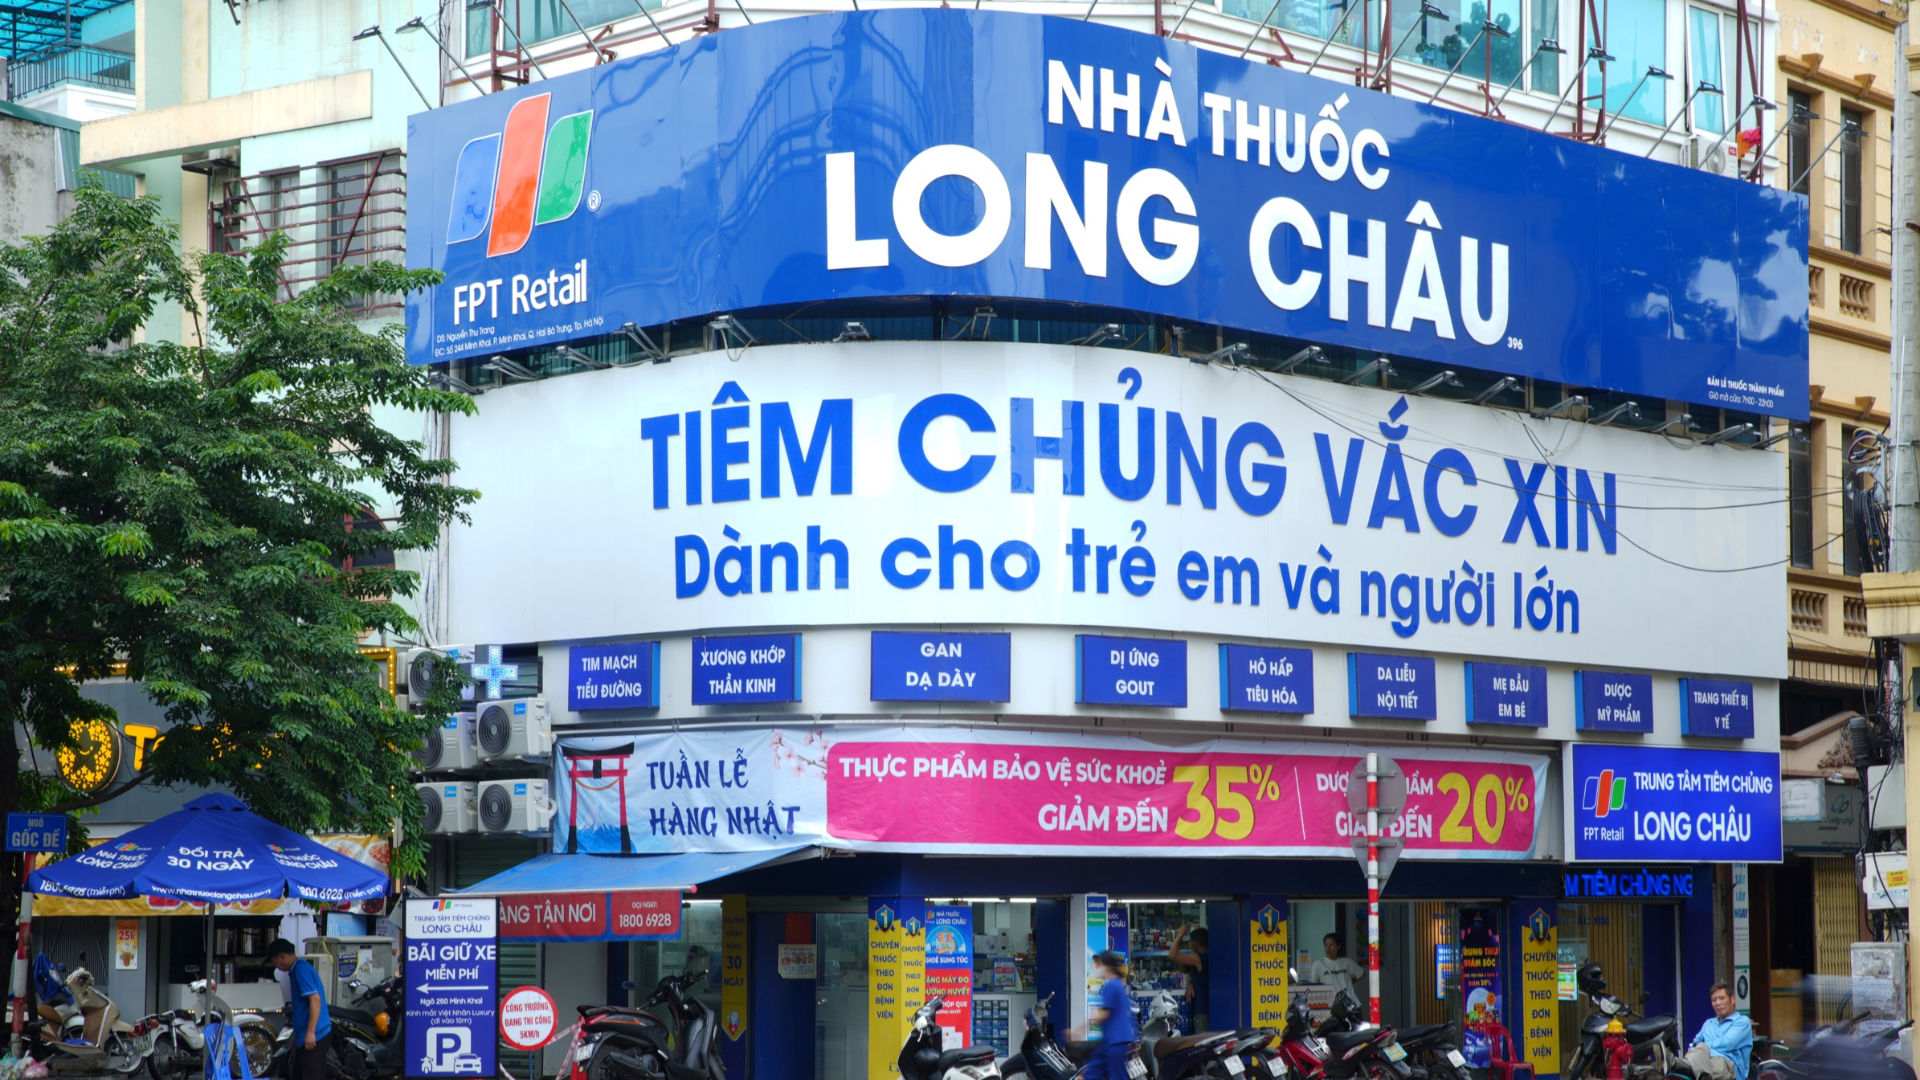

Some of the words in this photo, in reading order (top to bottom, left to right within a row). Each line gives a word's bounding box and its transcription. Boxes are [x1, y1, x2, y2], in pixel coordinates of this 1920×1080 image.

[1048, 57, 1187, 146] NHÀ
[1204, 92, 1390, 190] THUỐC
[825, 144, 1200, 286] LONG
[1249, 196, 1509, 345] CHÂU
[454, 278, 503, 325] FPT
[512, 259, 587, 314] Retail
[1507, 336, 1524, 352] 396
[1742, 396, 1754, 406] 7h00
[640, 380, 853, 510] TIÊM
[898, 366, 1287, 517] CHỦNG
[1314, 395, 1478, 537] VẮC
[1502, 457, 1617, 555] XIN
[675, 523, 849, 600] Dành
[880, 525, 1040, 592] cho
[1065, 519, 1156, 597] trẻ
[1177, 550, 1260, 606] em
[1279, 543, 1340, 615] và
[1360, 559, 1495, 638] người
[1513, 565, 1579, 634] lớn
[700, 650, 747, 666] XƯƠNG
[750, 645, 786, 664] KHỚP
[920, 642, 962, 657] GAN
[1110, 650, 1125, 669] DỊ
[1129, 647, 1160, 667] ỨNG
[582, 657, 600, 672] TIM
[603, 655, 637, 674] MẠCH
[1249, 657, 1267, 675] HÔ
[1269, 656, 1293, 677] HẤP
[1377, 666, 1393, 682] DA
[1395, 663, 1416, 683] LIỄU
[576, 678, 598, 699] TIỂU
[600, 682, 642, 698] ĐƯỜNG
[709, 672, 742, 695] THẦN
[746, 678, 776, 693] KINH
[906, 671, 932, 690] DẠ
[938, 668, 976, 687] DÀY
[1116, 680, 1154, 696] GOUT
[1493, 677, 1507, 695] MẸ
[1509, 672, 1529, 693] BẦU
[1246, 685, 1268, 703] TIÊU
[1272, 686, 1298, 705] HÓA
[1377, 690, 1397, 711] NỘI
[1399, 690, 1418, 709] TIẾT
[1604, 683, 1632, 701] DƯỢC
[1694, 691, 1719, 705] TRANG
[1720, 689, 1740, 706] THIẾT
[1742, 694, 1748, 710] BỊ
[1498, 703, 1512, 718] EM
[1514, 701, 1526, 718] BÉ
[1598, 706, 1611, 722] MỸ
[1614, 704, 1640, 723] PHẨM
[1714, 717, 1720, 729] Y
[1722, 713, 1730, 730] TẾ
[646, 748, 710, 790] TUẦN
[718, 747, 749, 789] LỄ
[839, 753, 907, 783] THỰC
[913, 750, 987, 779] PHẨM
[993, 753, 1041, 780] BẢO
[1045, 757, 1072, 787] VỆ
[1076, 758, 1112, 782] SỨC
[1116, 759, 1167, 785] KHOẺ
[1316, 772, 1349, 797] DƯỢ
[1634, 771, 1674, 792] TRUNG
[1677, 768, 1701, 792] TÂM
[1704, 770, 1730, 793] TIÊM
[1732, 770, 1773, 794] CHỦNG
[1038, 794, 1110, 832] GIẢM
[1116, 798, 1168, 832] ĐẾN
[1172, 764, 1281, 840] 35%
[1390, 805, 1432, 838] ĐẾN
[1436, 772, 1529, 844] 20%
[28, 817, 44, 828] NGÕ
[650, 801, 718, 837] HÀNG
[725, 800, 800, 840] NHẬT
[1634, 810, 1692, 841] LONG
[1696, 805, 1751, 842] CHÂU
[12, 827, 40, 848] GỐC
[42, 827, 60, 848] ĐỀ
[1584, 827, 1598, 841] FPT
[1600, 827, 1624, 841] Retail
[179, 846, 208, 858] ĐỔI
[213, 848, 244, 858] TRẢ
[167, 856, 191, 868] 30
[197, 859, 254, 870] NGÀY
[1582, 869, 1616, 896] TIÊM
[1619, 868, 1670, 896] CHỦNG
[437, 914, 450, 922] TÂM
[452, 914, 466, 922] TIÊM
[467, 913, 490, 921] CHỦNG
[500, 902, 530, 924] ÀNG
[534, 899, 564, 929] TẬN
[568, 903, 596, 923] NƠI
[619, 914, 643, 928] 1800
[646, 914, 672, 927] 6928
[952, 917, 966, 925] CHÂU
[118, 930, 136, 941] 25k
[422, 924, 452, 934] LONG
[454, 922, 482, 933] CHÂU
[408, 943, 436, 961] BÃI
[440, 942, 472, 960] GIỮ
[474, 945, 496, 960] XE
[1524, 950, 1556, 962] CHUYÊN
[426, 964, 456, 980] MIỄN
[459, 965, 480, 980] PHÍ
[1526, 968, 1554, 980] THUỐC
[1530, 990, 1552, 1000] THEO
[506, 1003, 523, 1012] CÔNG
[1532, 1008, 1550, 1018] ĐƠN
[504, 1017, 522, 1027] ĐANG
[524, 1017, 534, 1025] THI
[534, 1014, 551, 1024] CÔNG
[520, 1030, 540, 1038] 5KM/h
[1530, 1025, 1553, 1040] BỆNH
[436, 1033, 462, 1066] P
[1532, 1045, 1552, 1059] VIỆN
